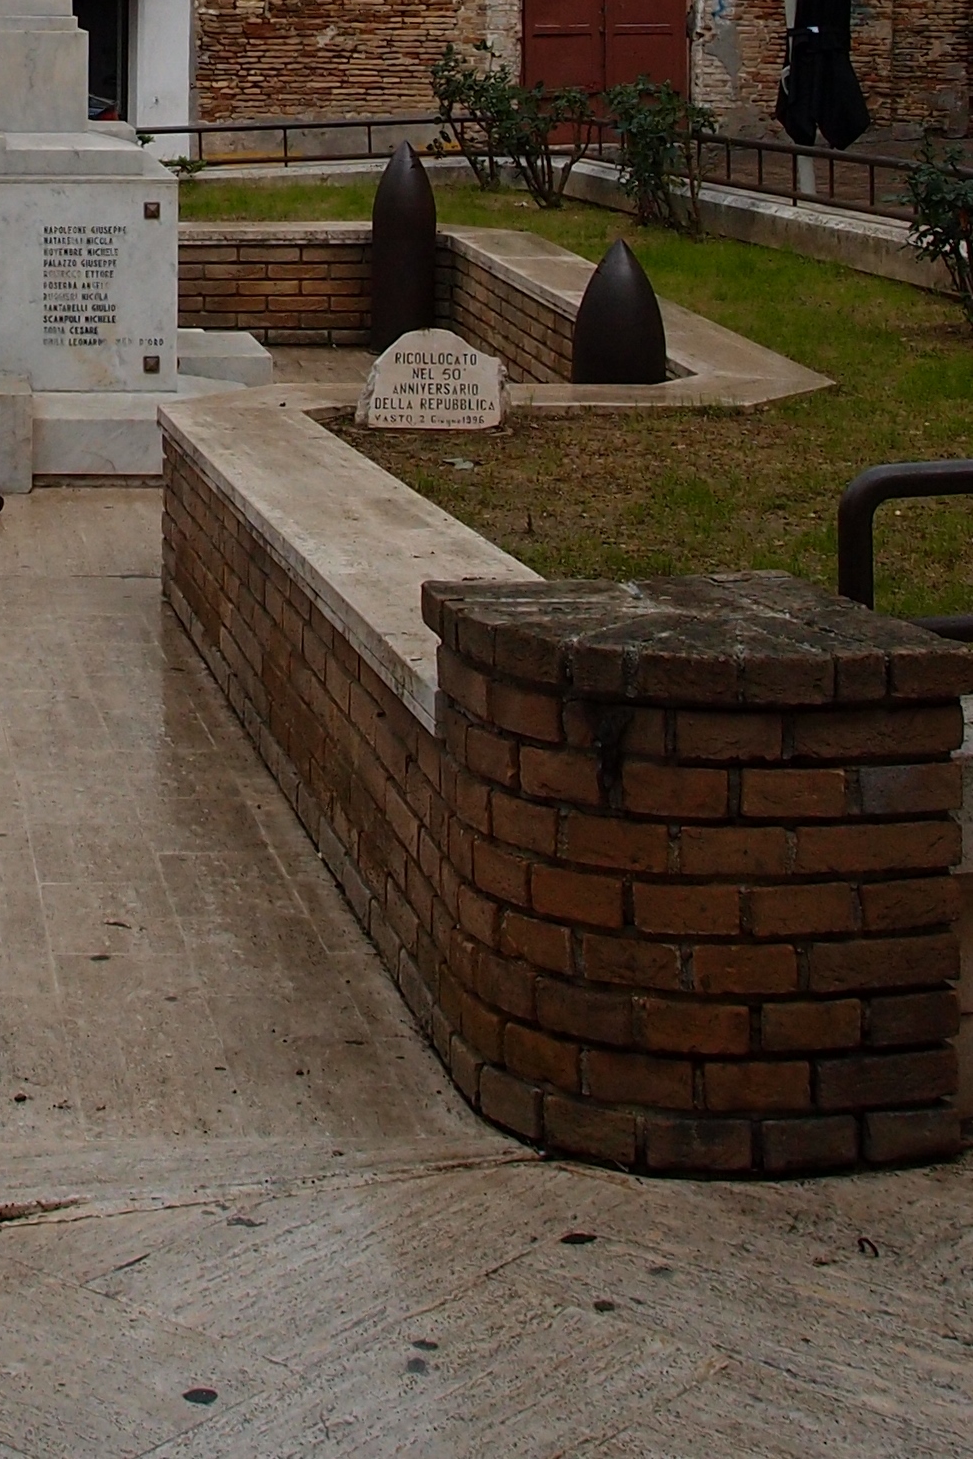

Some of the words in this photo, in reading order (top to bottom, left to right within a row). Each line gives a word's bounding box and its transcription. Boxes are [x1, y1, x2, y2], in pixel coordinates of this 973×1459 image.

[43, 259, 77, 267] PALAZZO
[80, 259, 117, 267] GIUSEPPE
[394, 352, 477, 365] RICOLLOCATO
[412, 368, 434, 380] NEL
[392, 383, 479, 396] ANNIVERSARIO
[374, 397, 413, 410] DELLA
[420, 398, 495, 411] REPUBBLICA
[420, 415, 425, 423] 2
